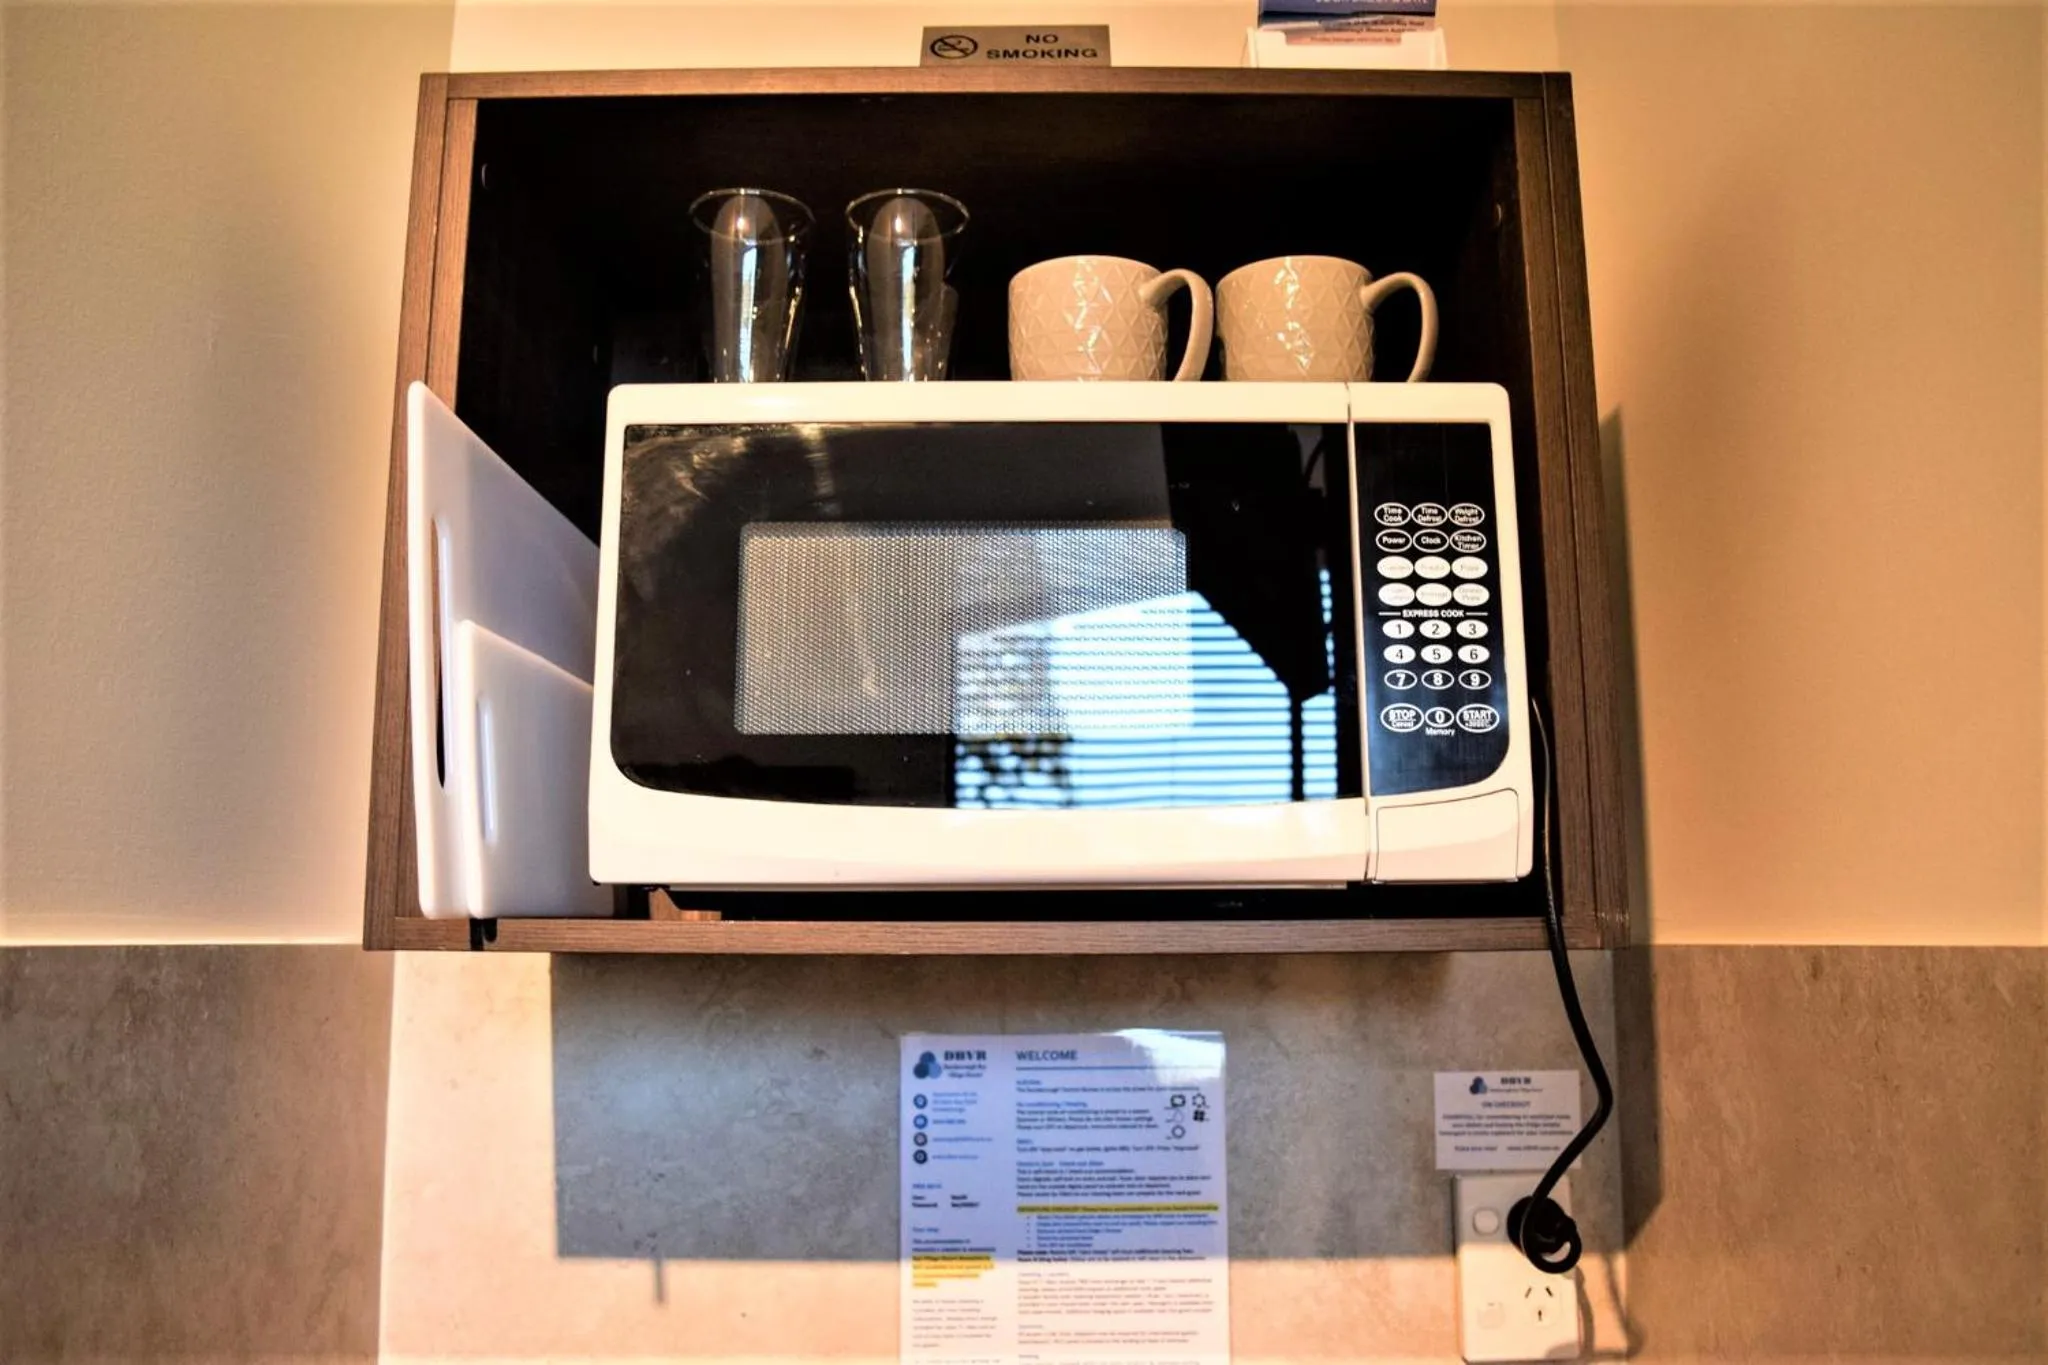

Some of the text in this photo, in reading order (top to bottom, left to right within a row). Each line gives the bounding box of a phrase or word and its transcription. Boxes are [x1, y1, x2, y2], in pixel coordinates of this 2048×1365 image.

[1025, 34, 1059, 44] NO
[986, 47, 1098, 60] SMOKING
[1383, 506, 1402, 514] Time
[1421, 506, 1438, 514] Time
[1383, 514, 1403, 522] Cook
[1382, 536, 1405, 544] Power
[1421, 536, 1441, 544] Clock
[1402, 610, 1464, 618] EXPRESS COOK
[1396, 623, 1402, 635] 1
[1431, 623, 1440, 635] 2
[1468, 623, 1477, 635] 3
[1395, 649, 1404, 660] 4
[1432, 649, 1441, 660] 5
[1470, 648, 1478, 660] 6
[1396, 673, 1406, 687] 7
[1433, 672, 1443, 686] 8
[1470, 673, 1480, 687] 9
[1388, 709, 1416, 719] STOP
[1435, 710, 1445, 724] 0
[1463, 710, 1492, 720] START
[1425, 727, 1455, 737] Memory
[1016, 1050, 1078, 1061] WELCOME
